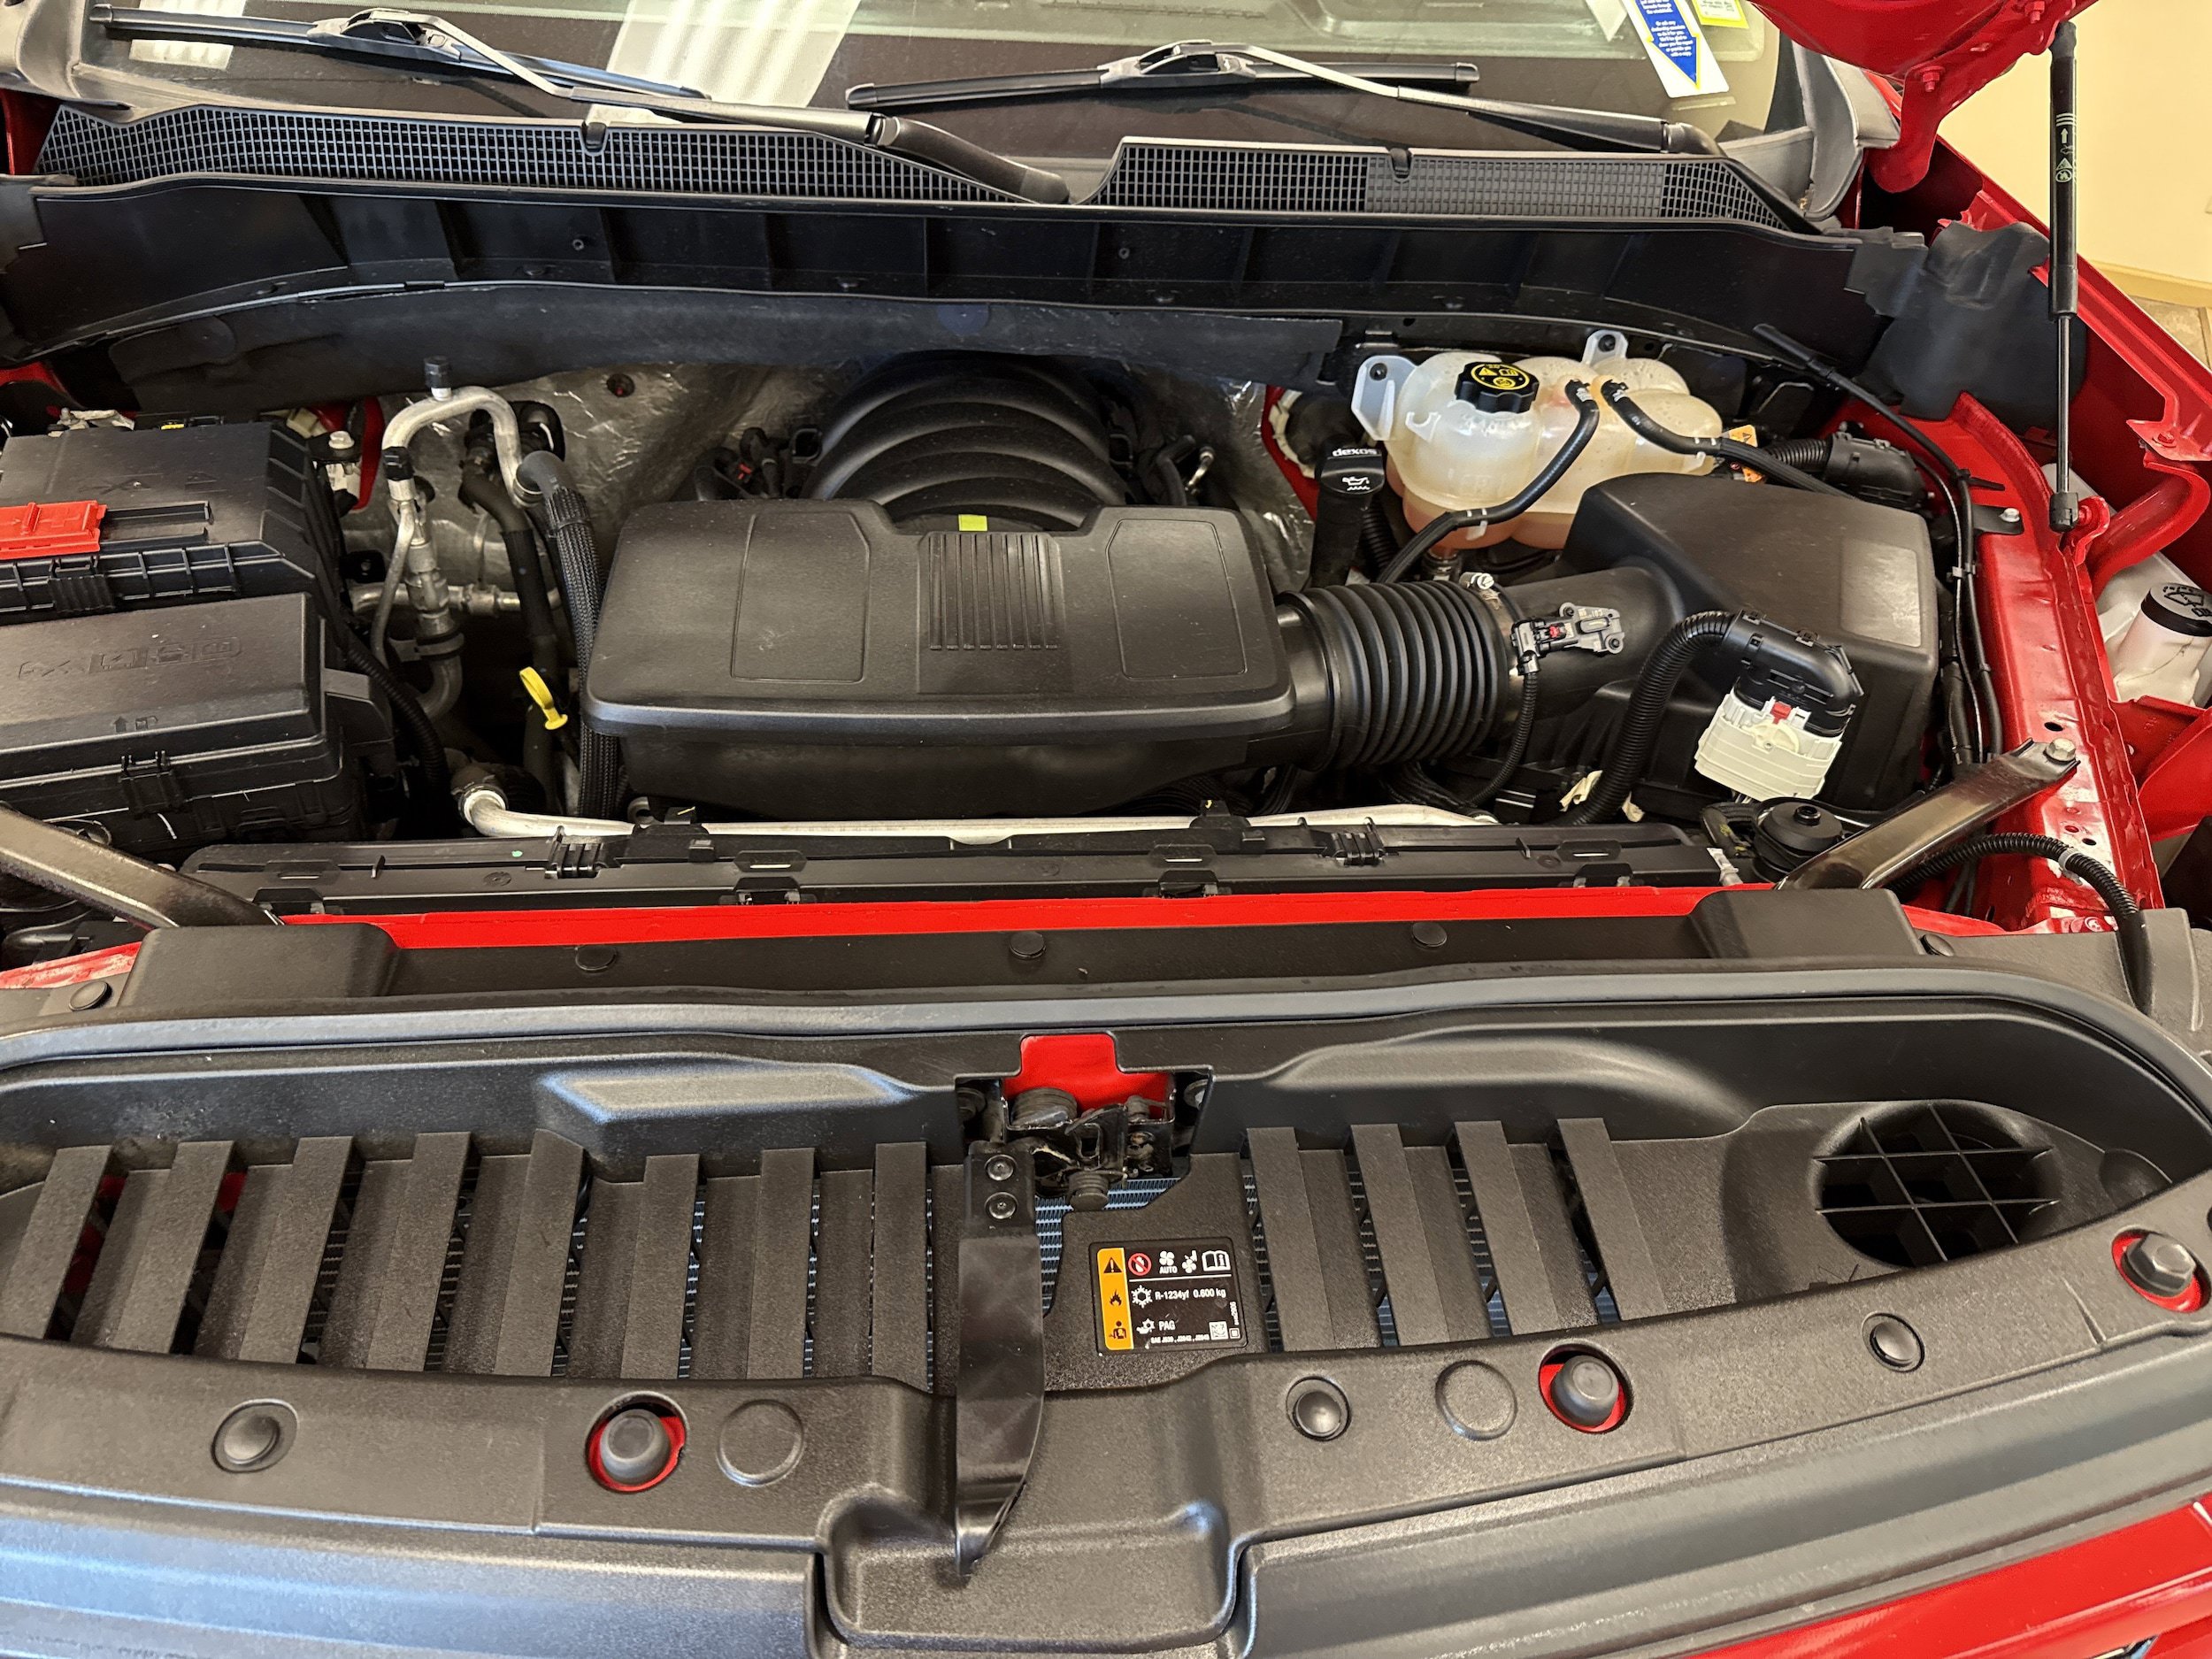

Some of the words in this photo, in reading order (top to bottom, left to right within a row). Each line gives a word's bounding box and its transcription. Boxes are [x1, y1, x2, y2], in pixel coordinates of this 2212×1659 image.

[1332, 448, 1378, 457] dexos
[1159, 1265, 1178, 1274] AUTO
[1155, 1289, 1189, 1301] R-1234yf
[1193, 1287, 1215, 1298] 0.600
[1215, 1287, 1226, 1298] kg
[1158, 1320, 1176, 1331] PAG
